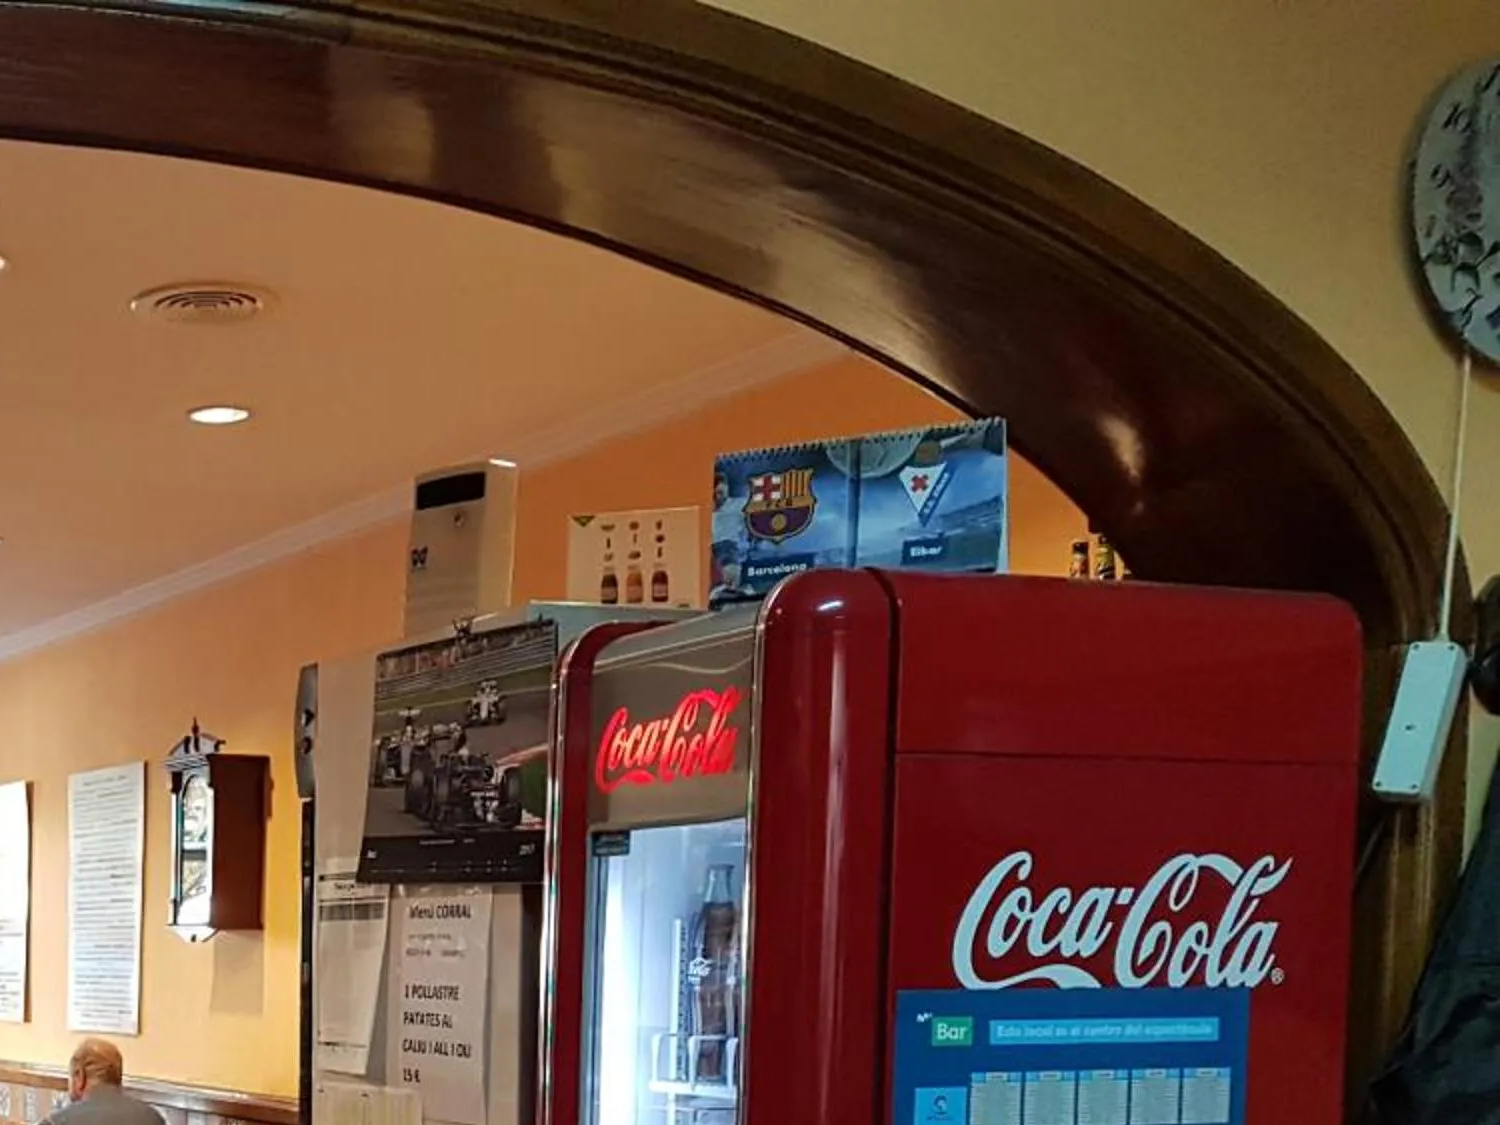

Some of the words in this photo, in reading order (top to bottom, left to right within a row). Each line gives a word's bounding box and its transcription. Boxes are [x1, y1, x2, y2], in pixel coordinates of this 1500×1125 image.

[910, 545, 943, 557] Eibar
[747, 562, 807, 577] Barcelona
[596, 685, 741, 795] Coca-Cola
[436, 904, 471, 919] CORRAL
[952, 850, 1292, 990] Coca-Cola
[411, 985, 460, 1001] POLLASTRE
[403, 1011, 440, 1027] PATATES
[937, 1022, 968, 1040] Bar
